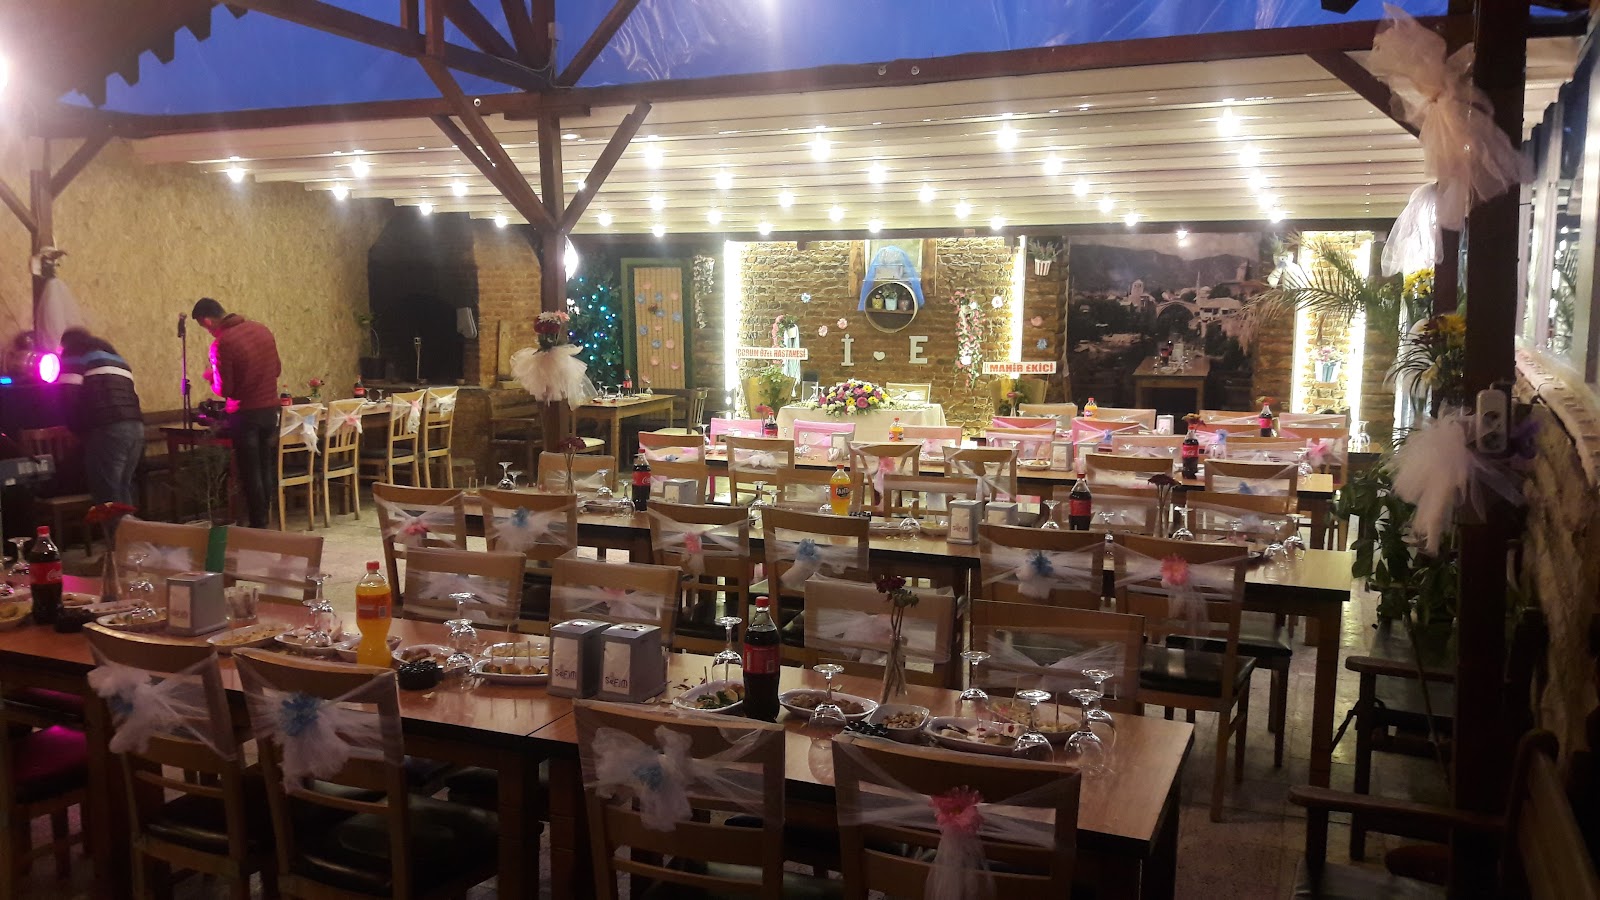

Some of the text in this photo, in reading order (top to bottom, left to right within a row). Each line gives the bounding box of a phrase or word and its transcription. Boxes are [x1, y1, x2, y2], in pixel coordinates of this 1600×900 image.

[774, 348, 805, 358] HASTANESİ
[909, 336, 929, 364] E
[990, 363, 1023, 372] MAHİR
[1026, 363, 1053, 372] EKİCİ
